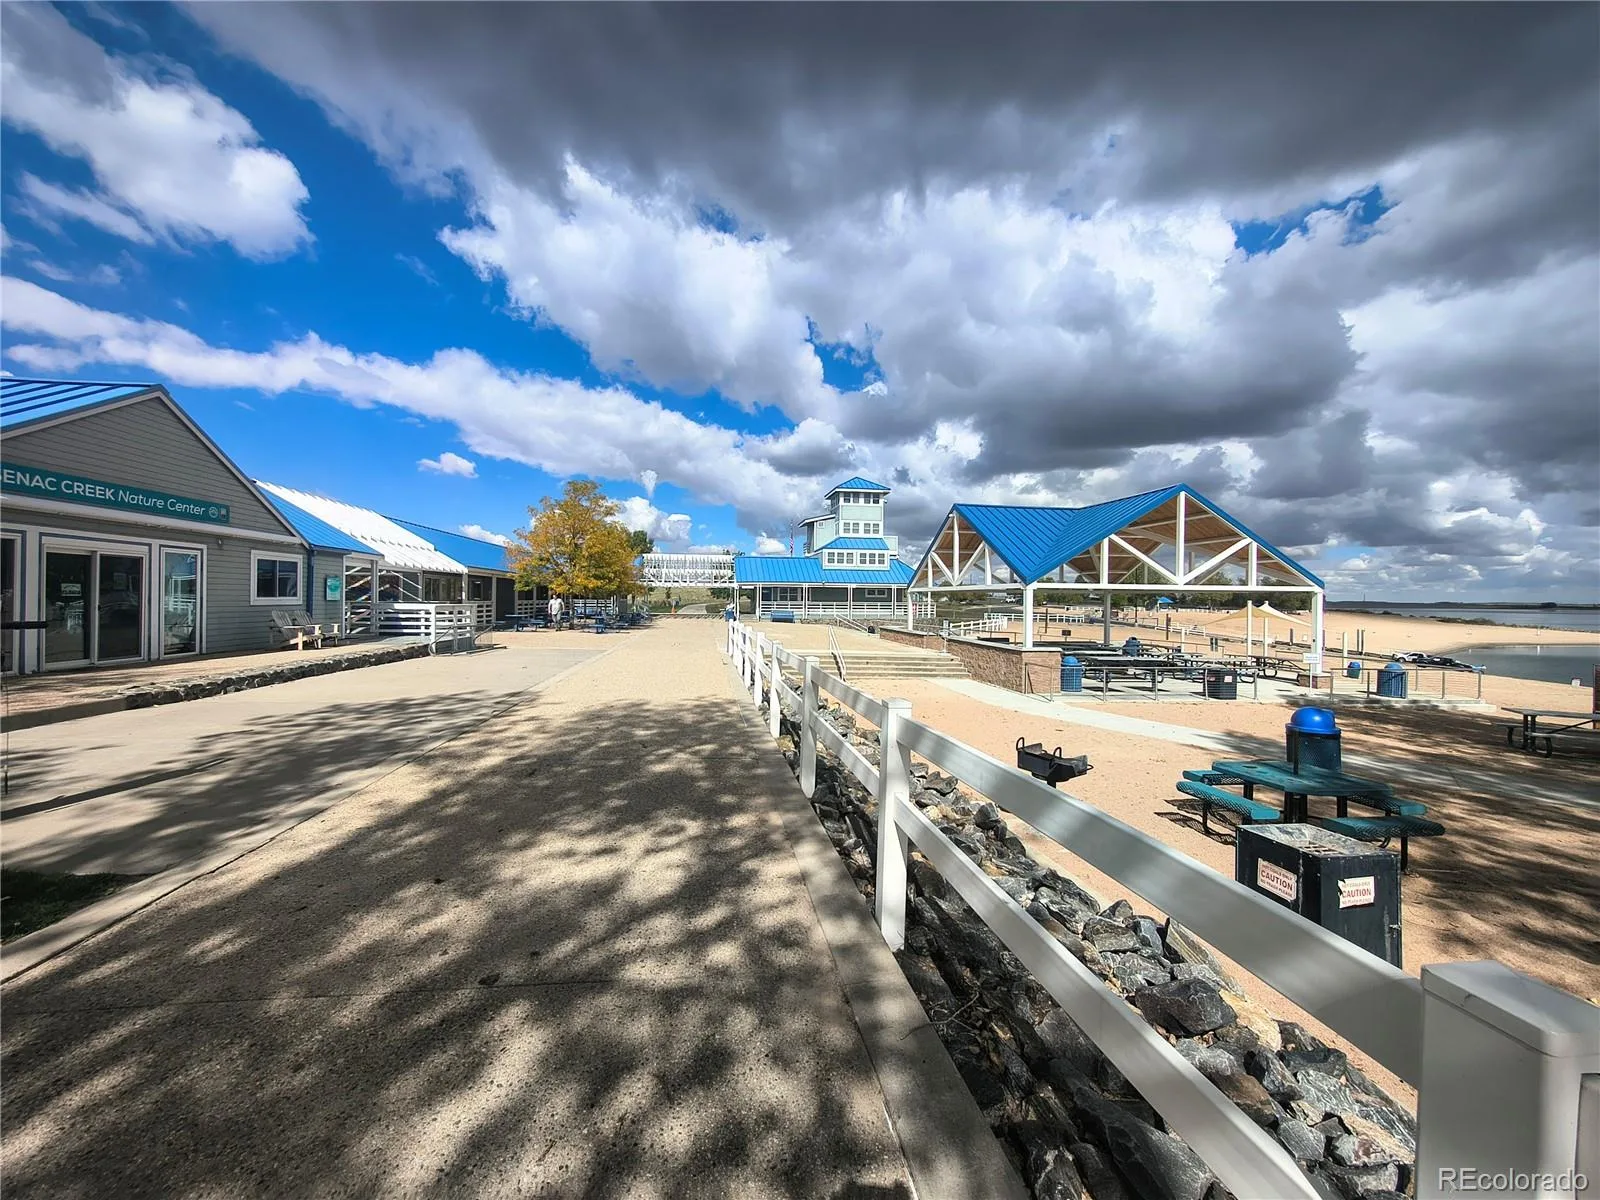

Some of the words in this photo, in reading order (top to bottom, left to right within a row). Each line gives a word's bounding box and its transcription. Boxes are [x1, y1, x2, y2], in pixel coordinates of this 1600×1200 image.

[0, 467, 57, 491] ENAC
[61, 480, 115, 501] CREEK
[118, 490, 165, 509] Nature
[167, 498, 206, 516] Center
[1261, 870, 1293, 891] CAUTION
[1342, 888, 1372, 898] CAUTION
